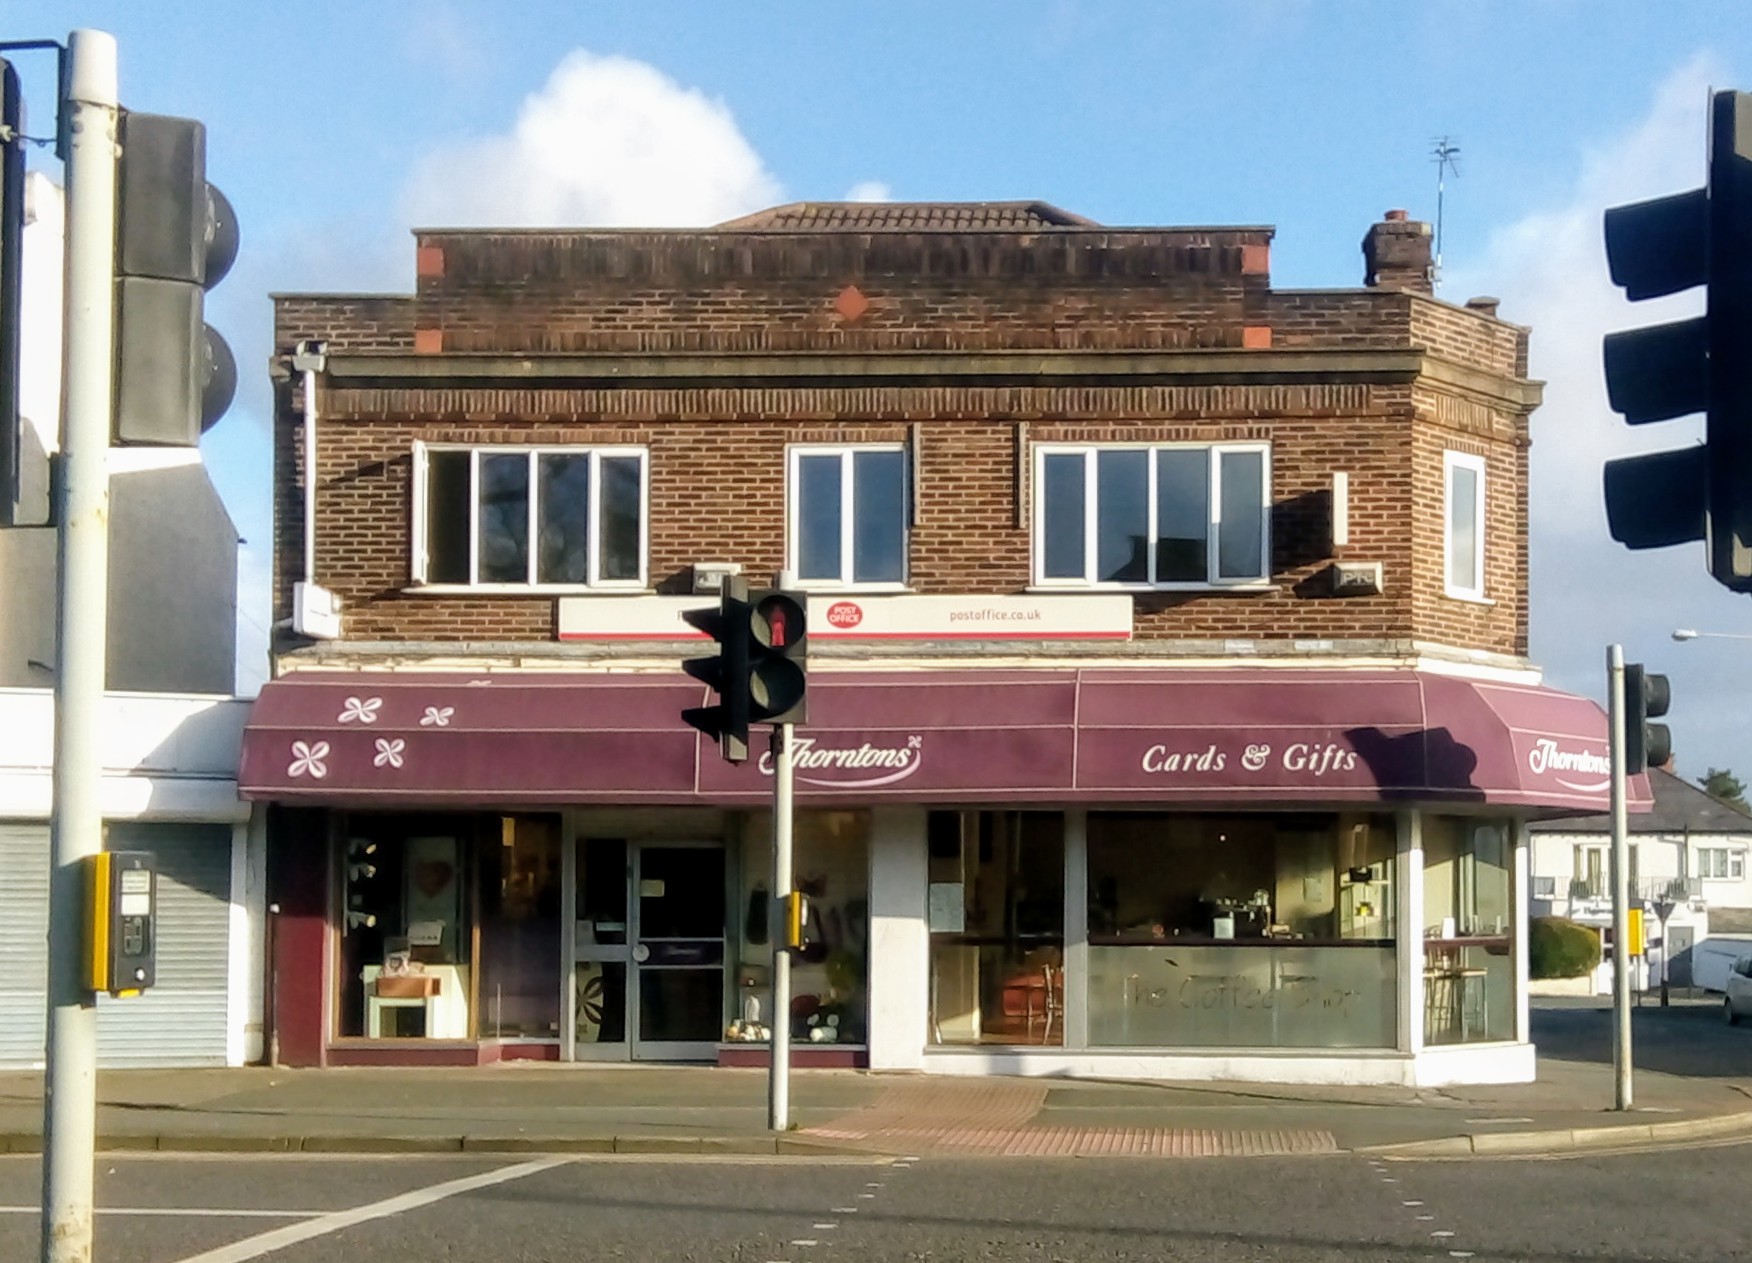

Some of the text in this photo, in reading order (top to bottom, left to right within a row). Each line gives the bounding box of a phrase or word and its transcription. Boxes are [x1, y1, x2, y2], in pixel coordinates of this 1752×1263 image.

[833, 606, 857, 615] POST
[949, 609, 1042, 622] postoffice.co.uk
[829, 613, 860, 623] OFFICE
[1141, 743, 1358, 777] Cards & Gifts
